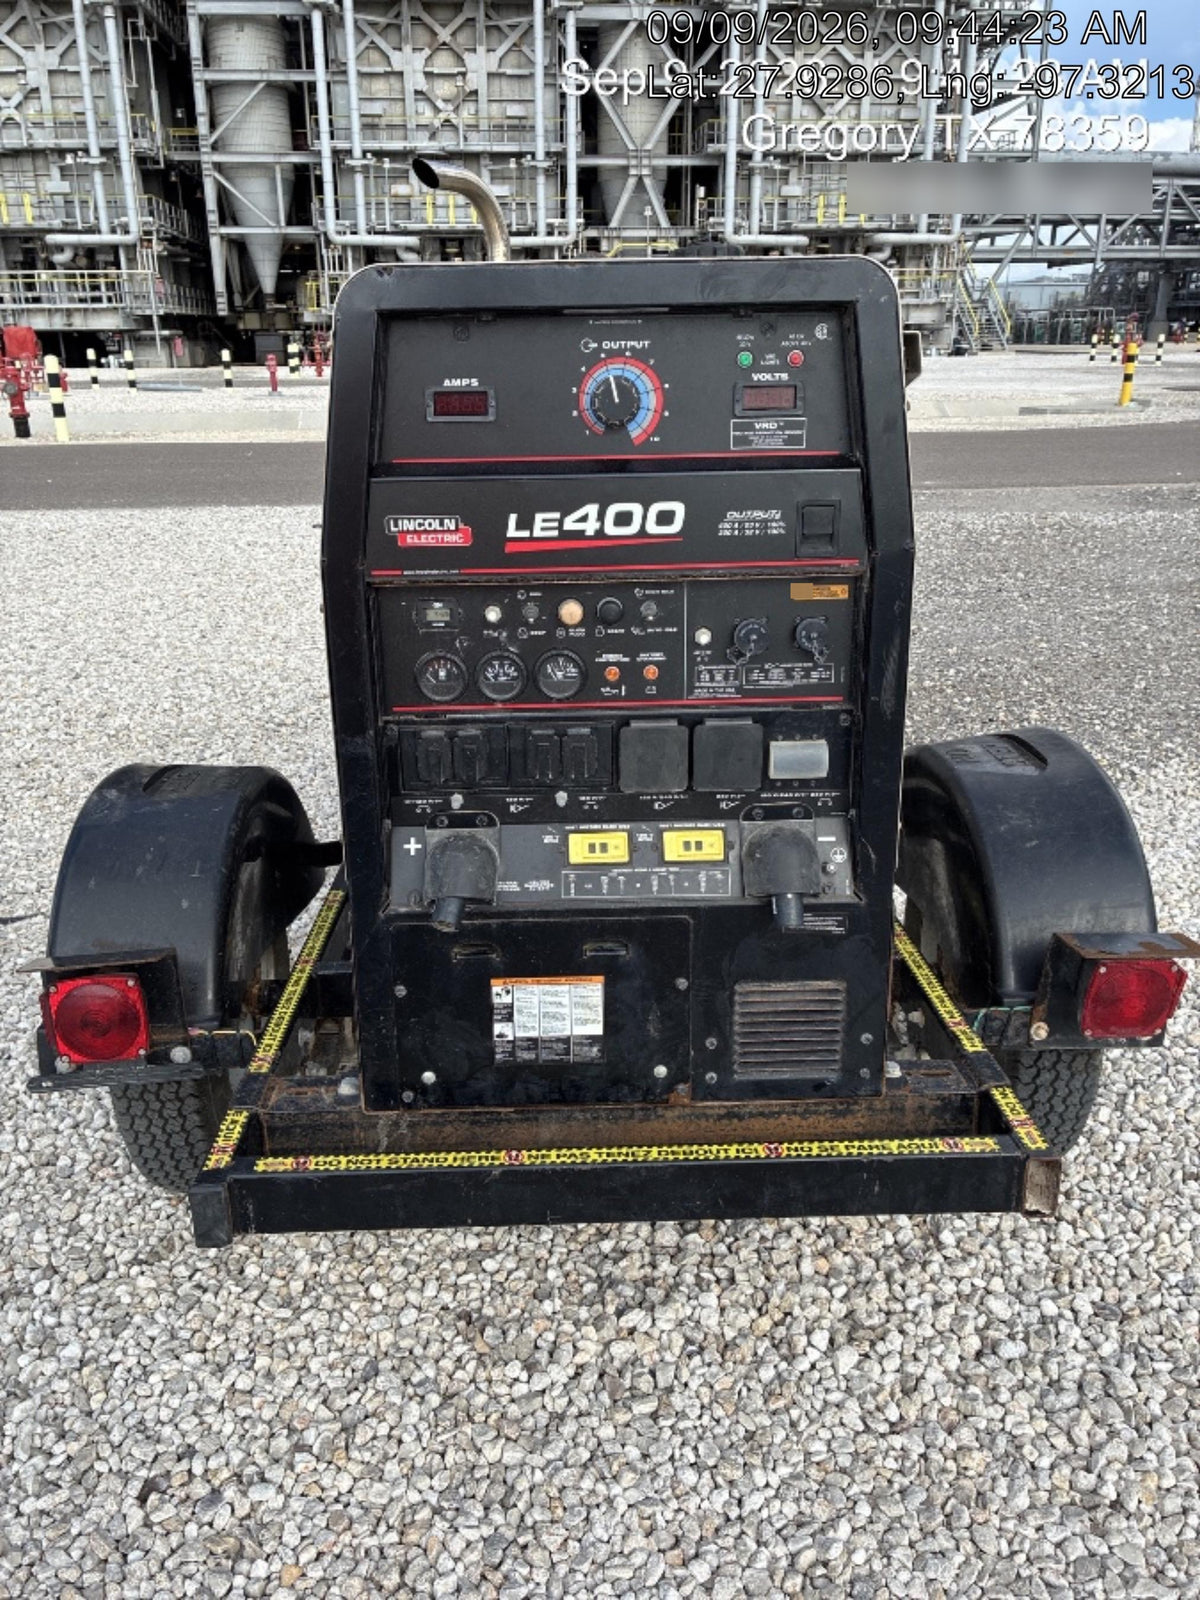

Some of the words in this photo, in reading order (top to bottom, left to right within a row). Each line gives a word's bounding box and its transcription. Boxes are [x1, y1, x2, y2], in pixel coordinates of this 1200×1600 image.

[602, 341, 651, 349] OUTPUT
[751, 372, 789, 381] VOLTS
[442, 378, 480, 387] AMPS
[389, 517, 456, 532] LINCOLN
[505, 501, 686, 538] LE400
[406, 533, 464, 543] ELECTRIC
[314, 1159, 341, 1167] DO
[346, 1157, 385, 1166] NOT
[388, 1156, 449, 1165] STAND
[453, 1154, 500, 1164] HERE
[527, 1153, 552, 1161] NE
[556, 1152, 591, 1161] PAS
[595, 1150, 653, 1159] TENEZ
[657, 1148, 731, 1158] DEBOUT
[737, 1147, 759, 1155] ICI
[787, 1145, 813, 1153] NO
[817, 1145, 840, 1153] SE
